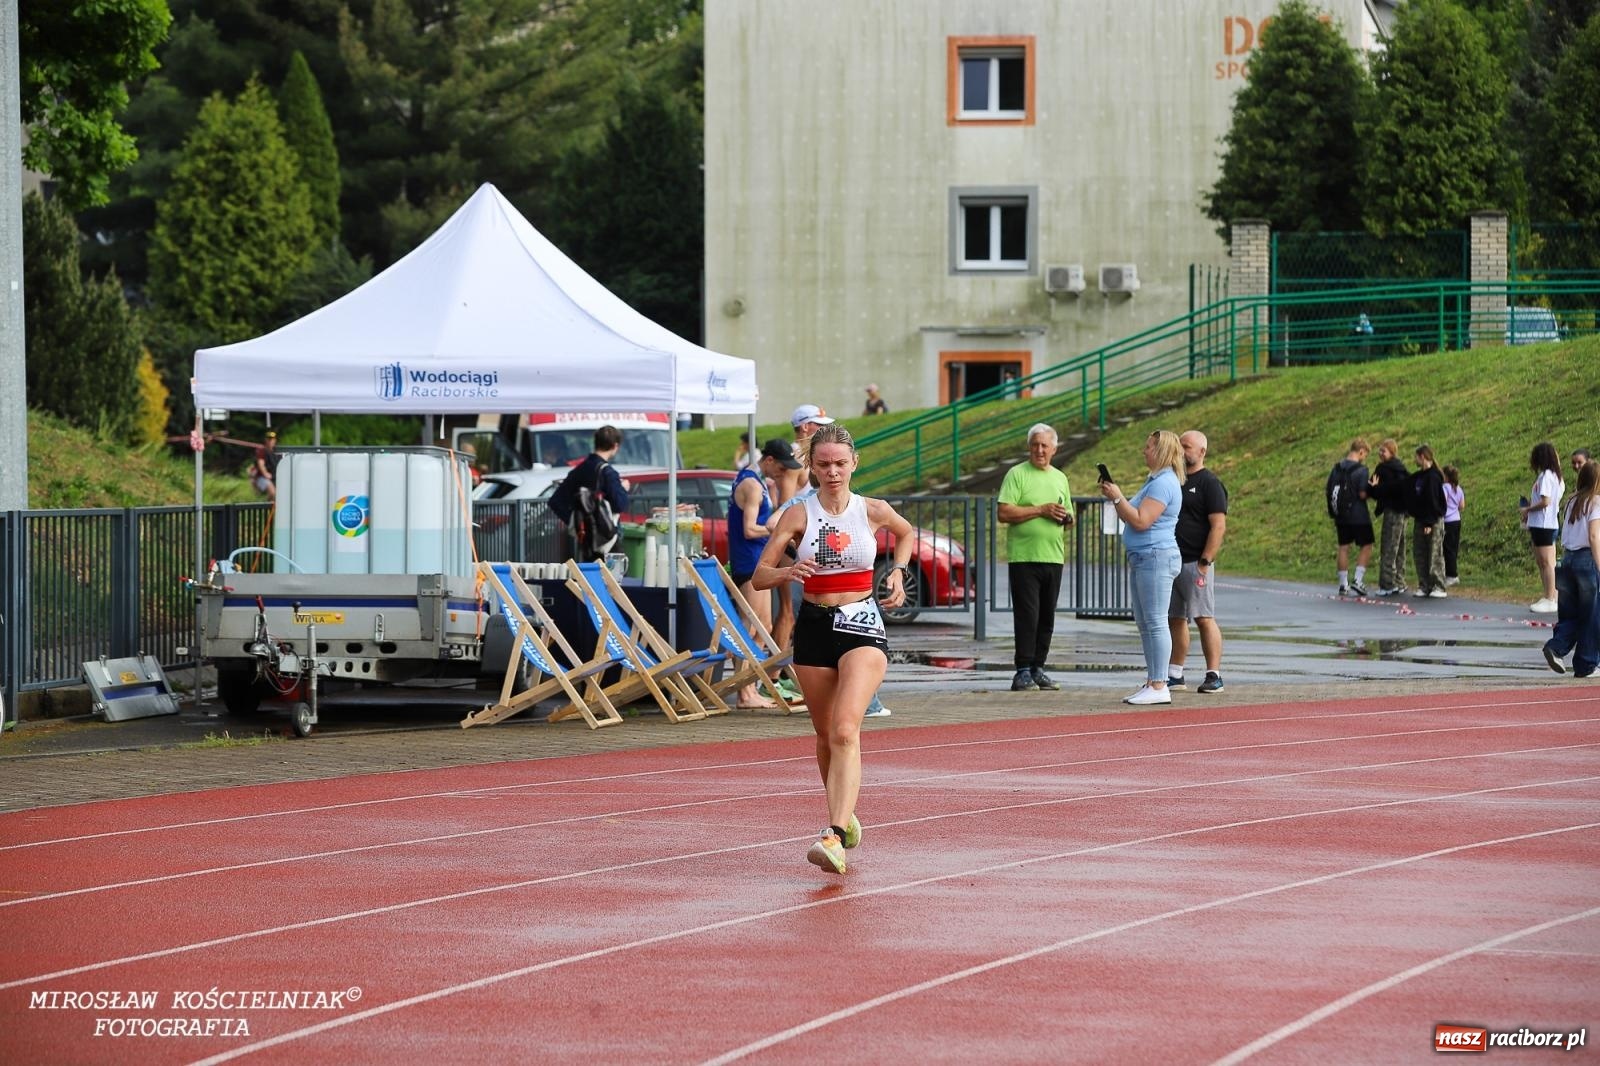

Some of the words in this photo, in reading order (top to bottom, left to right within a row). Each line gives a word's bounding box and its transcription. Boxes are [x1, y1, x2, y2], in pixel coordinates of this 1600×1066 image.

[410, 370, 498, 387] Wodociągi
[411, 386, 498, 398] Raciborskie
[844, 611, 876, 626] 223
